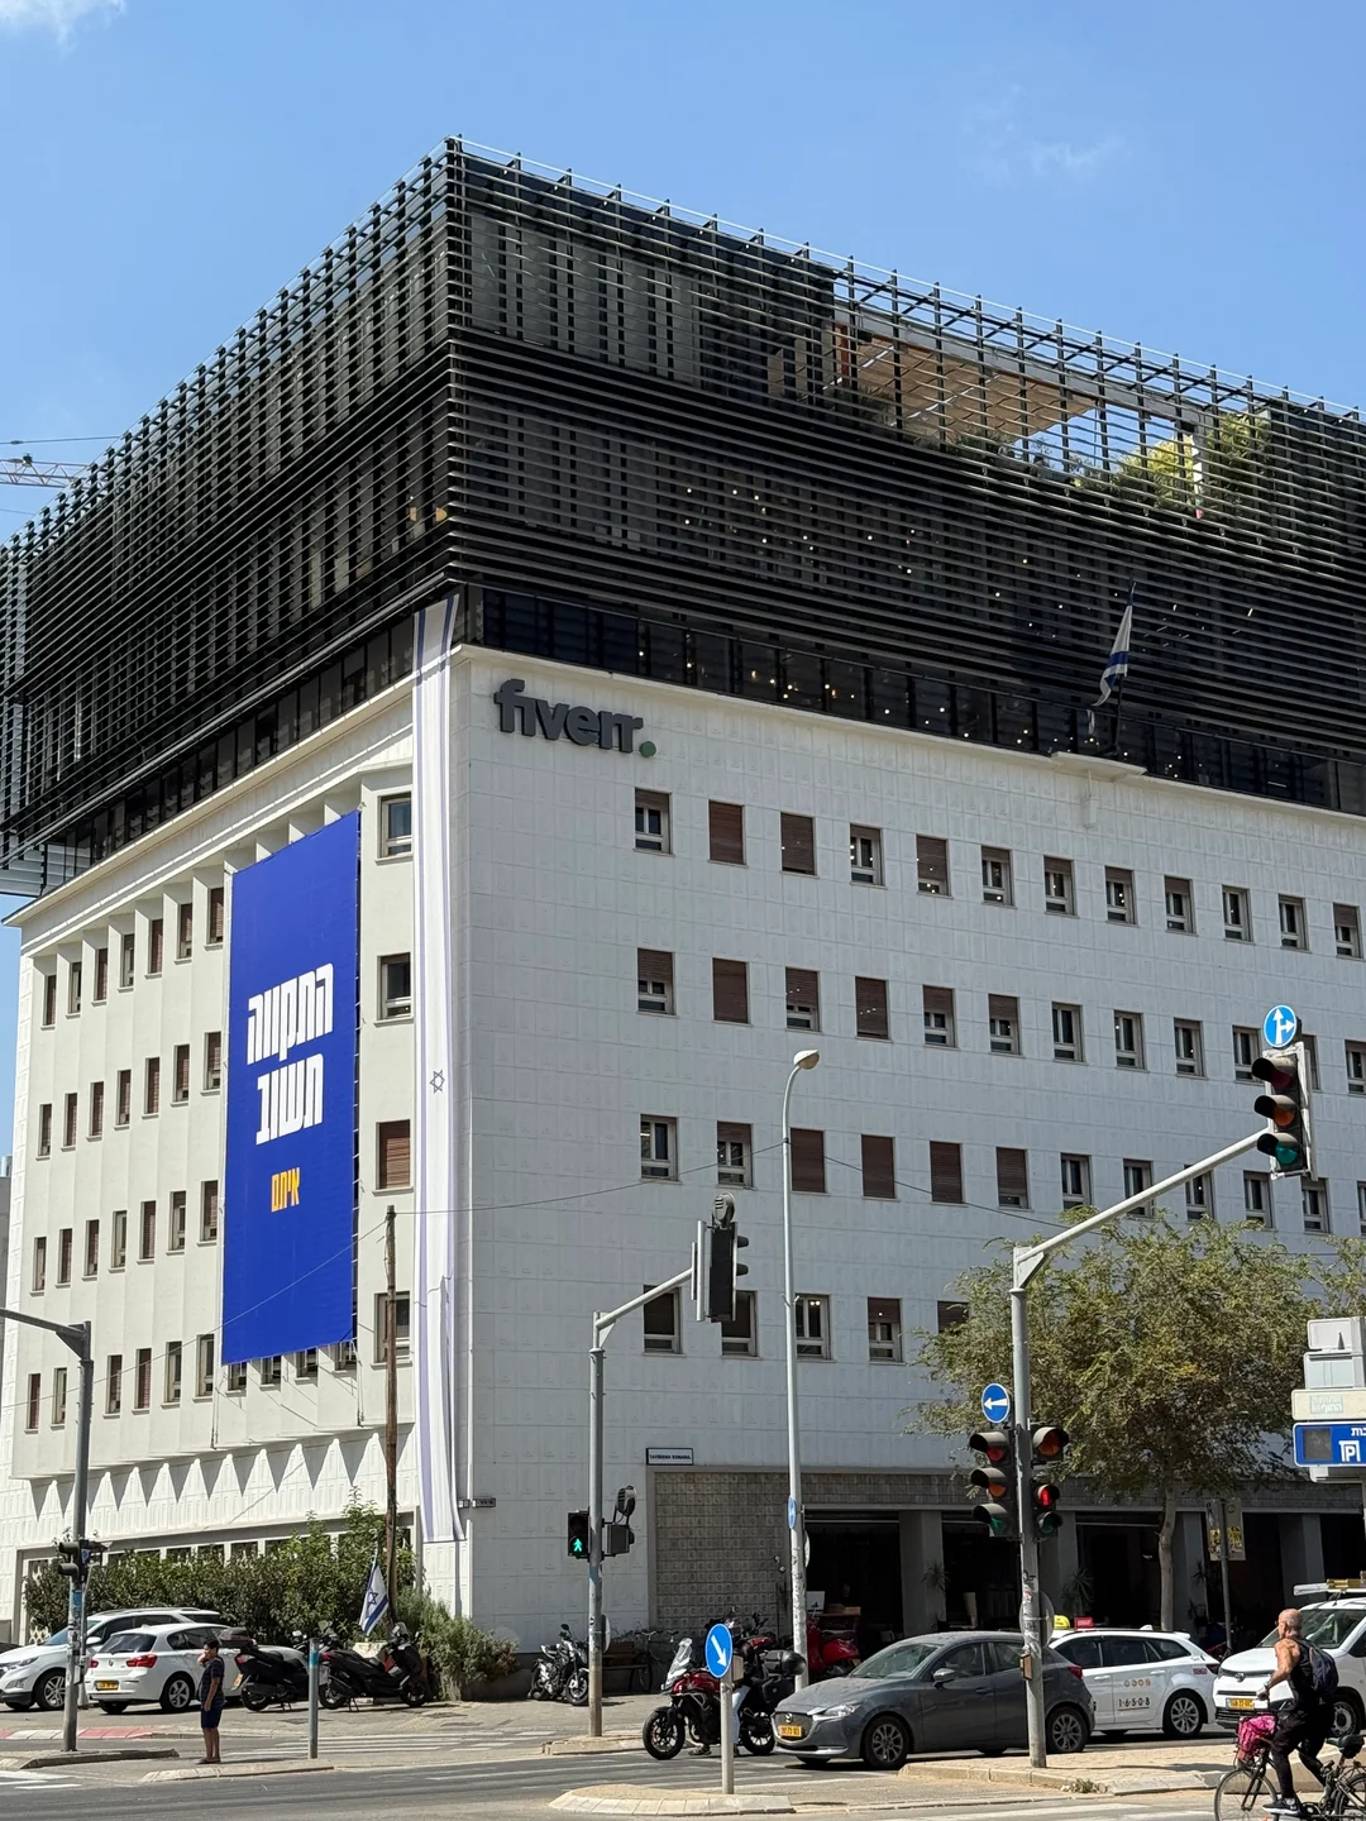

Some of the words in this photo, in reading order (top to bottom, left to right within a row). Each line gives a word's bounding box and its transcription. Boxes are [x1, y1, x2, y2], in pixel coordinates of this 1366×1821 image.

[247, 963, 334, 1065] התקווה
[255, 1053, 324, 1146] תשוב
[271, 1167, 301, 1212] איתם
